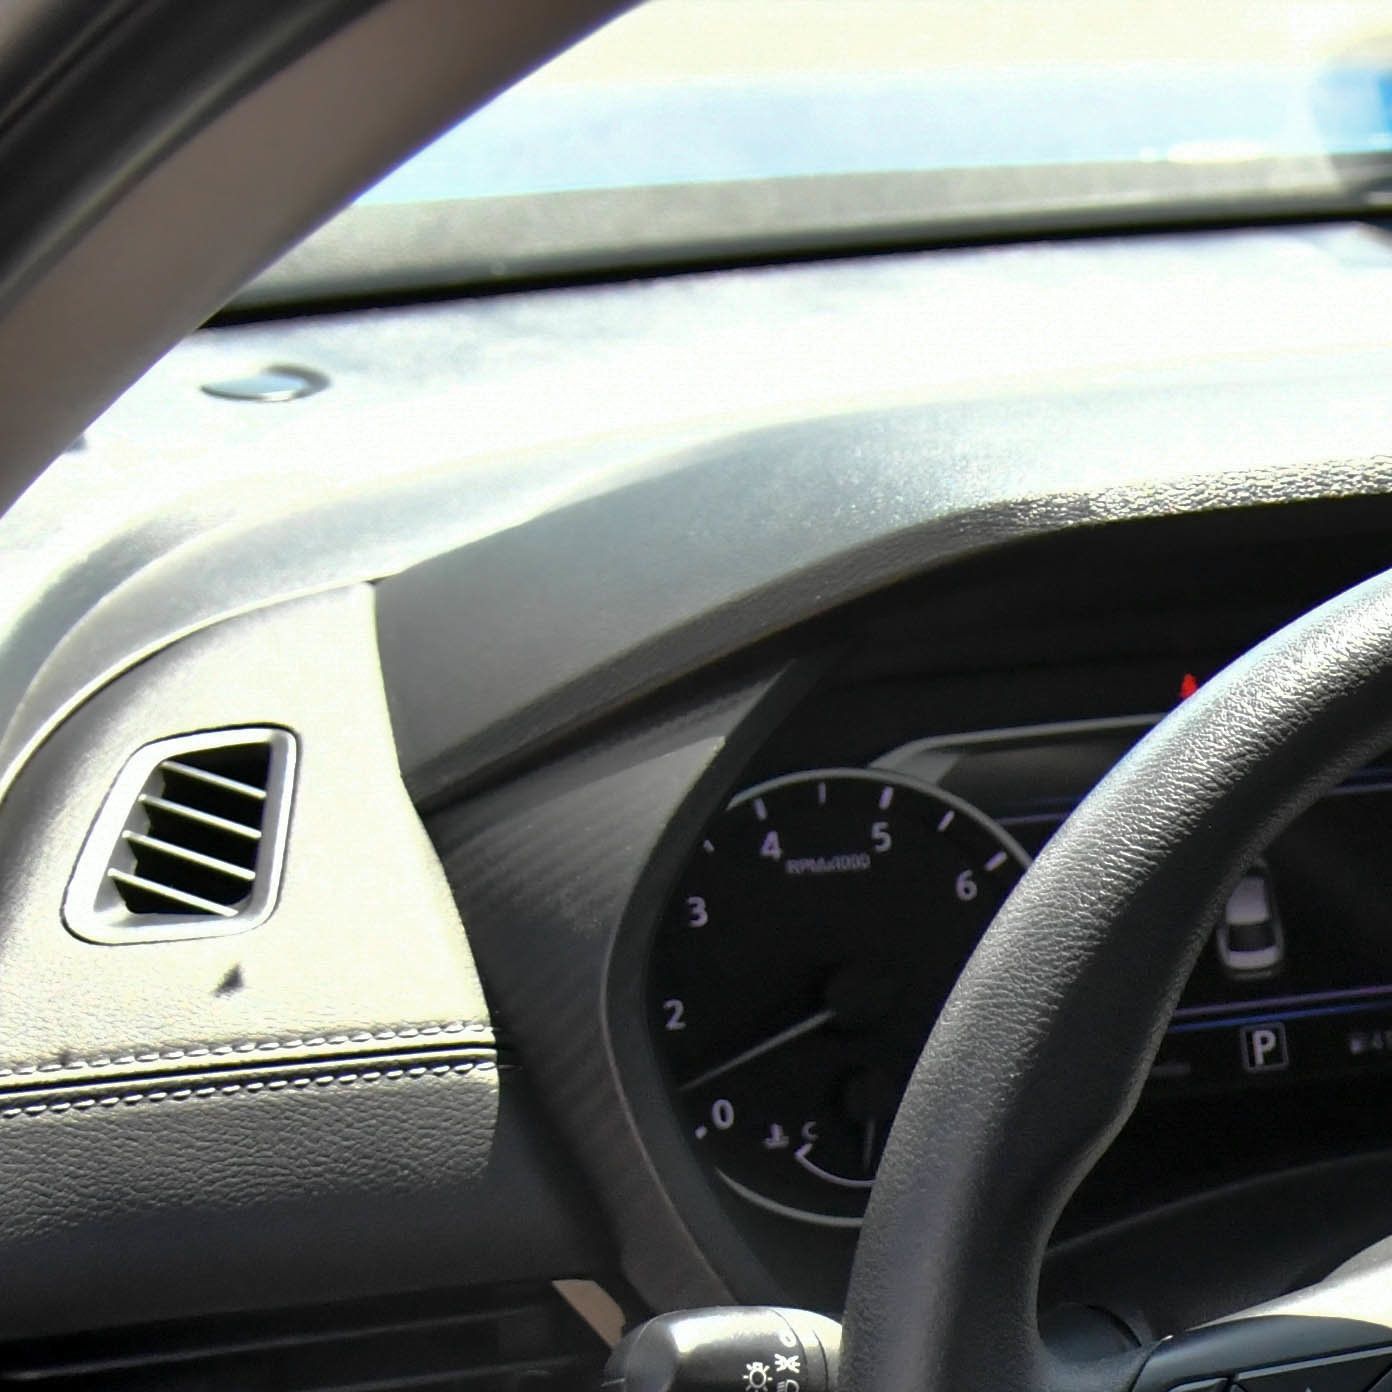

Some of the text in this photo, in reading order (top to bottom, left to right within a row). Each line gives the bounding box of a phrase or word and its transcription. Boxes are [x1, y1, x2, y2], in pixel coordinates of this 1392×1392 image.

[761, 831, 781, 860] 4
[871, 821, 893, 852] 5
[956, 870, 978, 901] 6
[687, 896, 708, 927] 3
[663, 999, 686, 1031] 2
[1252, 1029, 1276, 1065] P
[711, 1099, 735, 1130] 0
